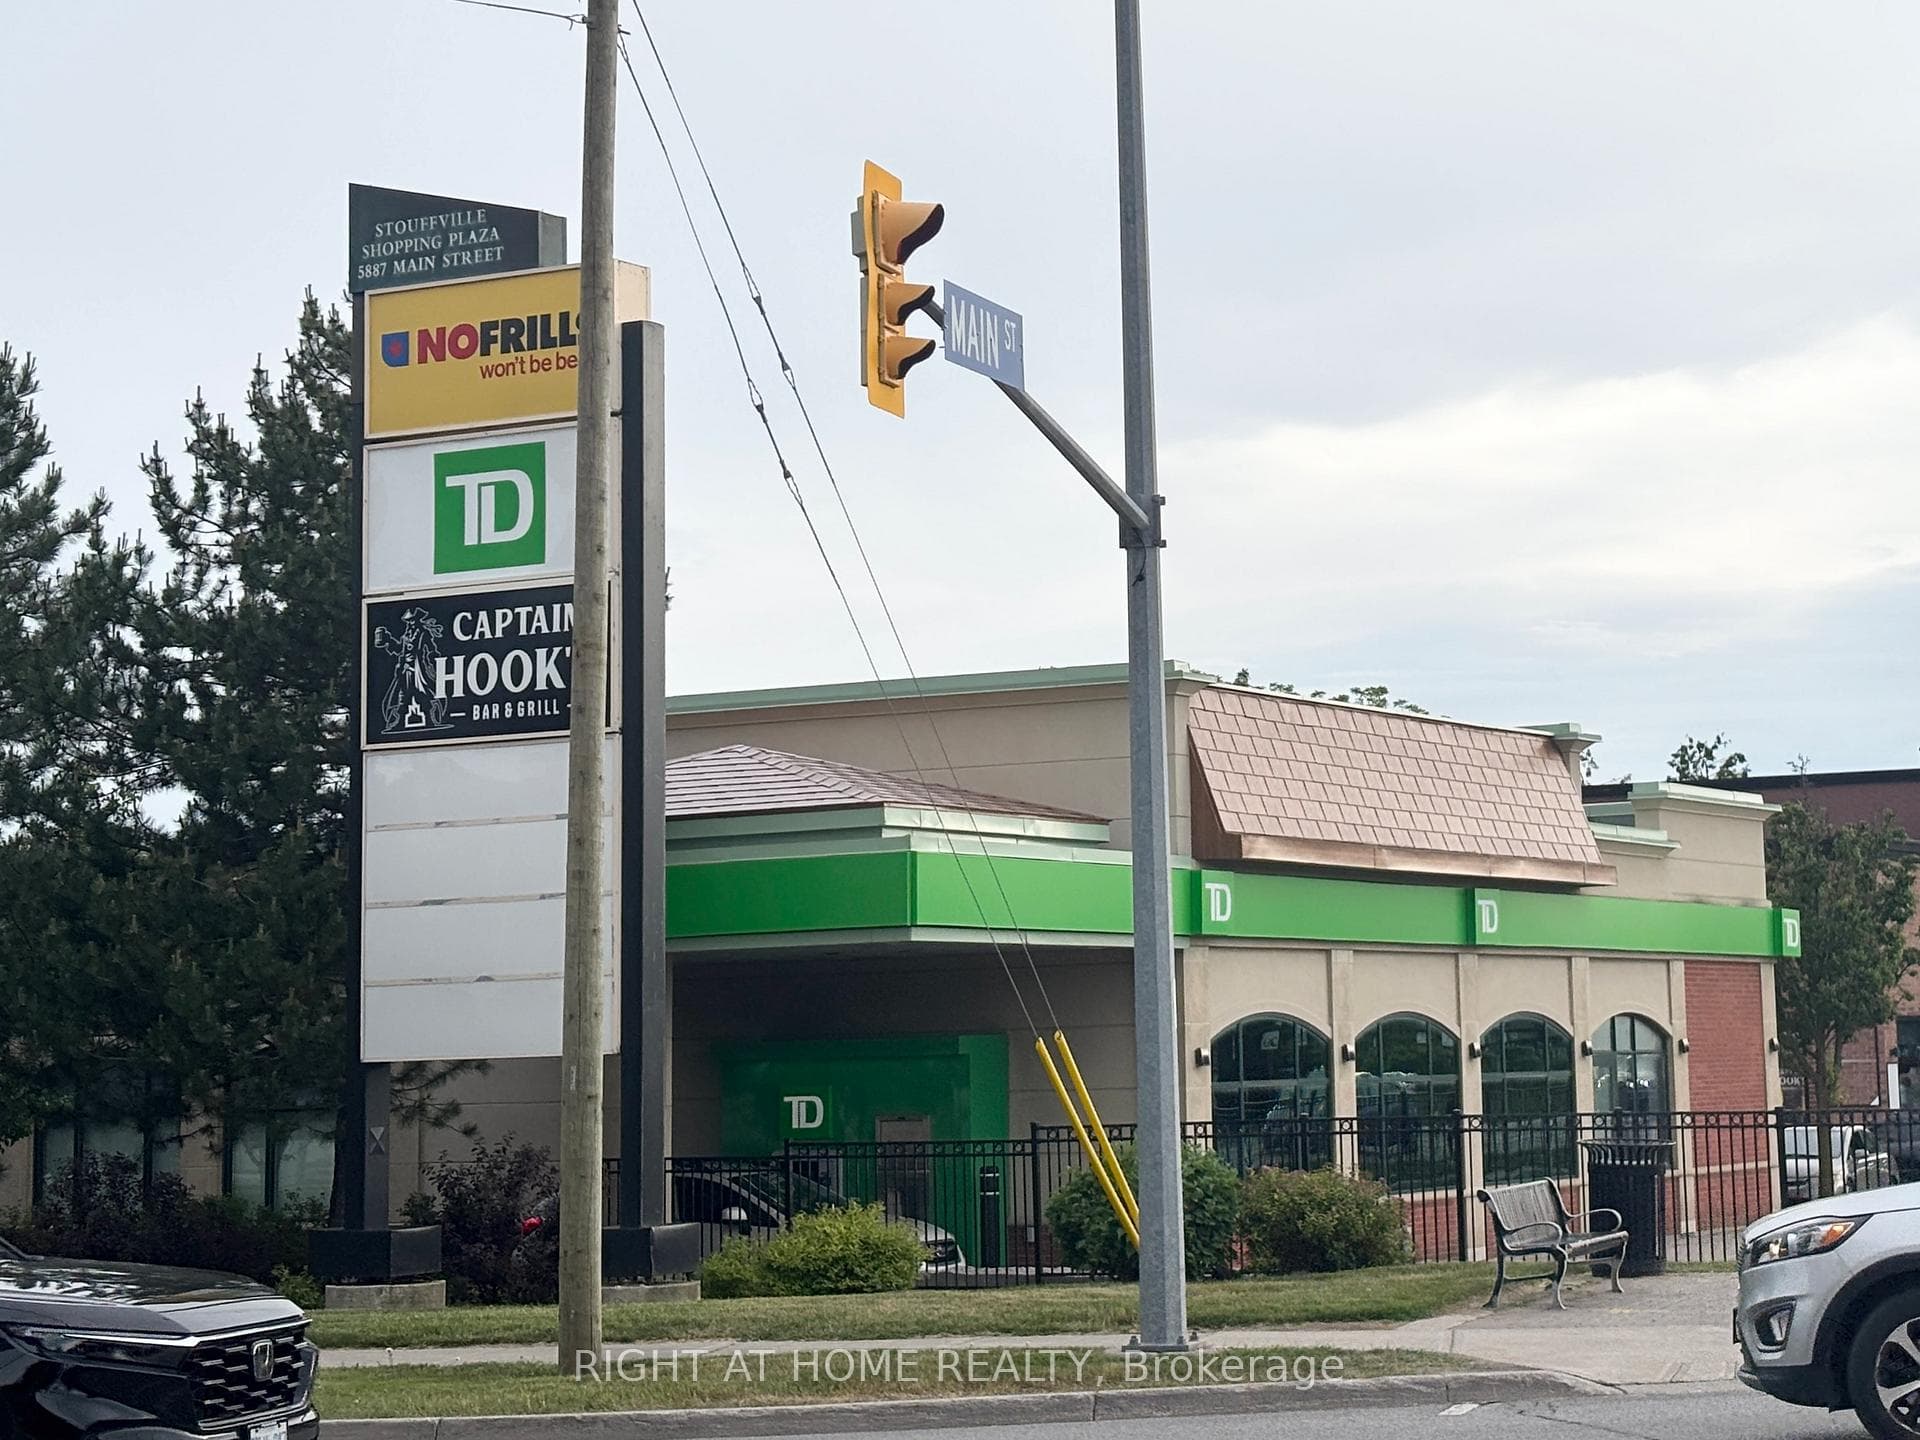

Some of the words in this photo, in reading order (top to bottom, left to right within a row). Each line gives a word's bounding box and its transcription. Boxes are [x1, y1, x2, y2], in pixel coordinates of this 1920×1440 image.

[375, 208, 487, 238] STOUFFVILLE
[362, 235, 441, 259] SHOPPING
[449, 227, 500, 246] PLAZA
[358, 262, 387, 279] 5887
[393, 256, 436, 274] MAIN
[442, 246, 504, 268] STREET
[417, 311, 580, 364] NOFRILL
[950, 295, 1000, 370] MAIN
[1004, 319, 1016, 352] ST
[480, 355, 526, 379] won't
[530, 354, 552, 372] be
[556, 351, 578, 371] be
[445, 469, 534, 546] TD
[453, 603, 574, 641] CAPTAIN
[434, 646, 571, 699] HOOK'
[472, 702, 500, 721] BAR
[517, 698, 560, 717] GRILL
[1205, 882, 1232, 921] TD
[1477, 899, 1499, 934] TD
[1783, 918, 1799, 947] TD
[783, 1095, 824, 1129] TD
